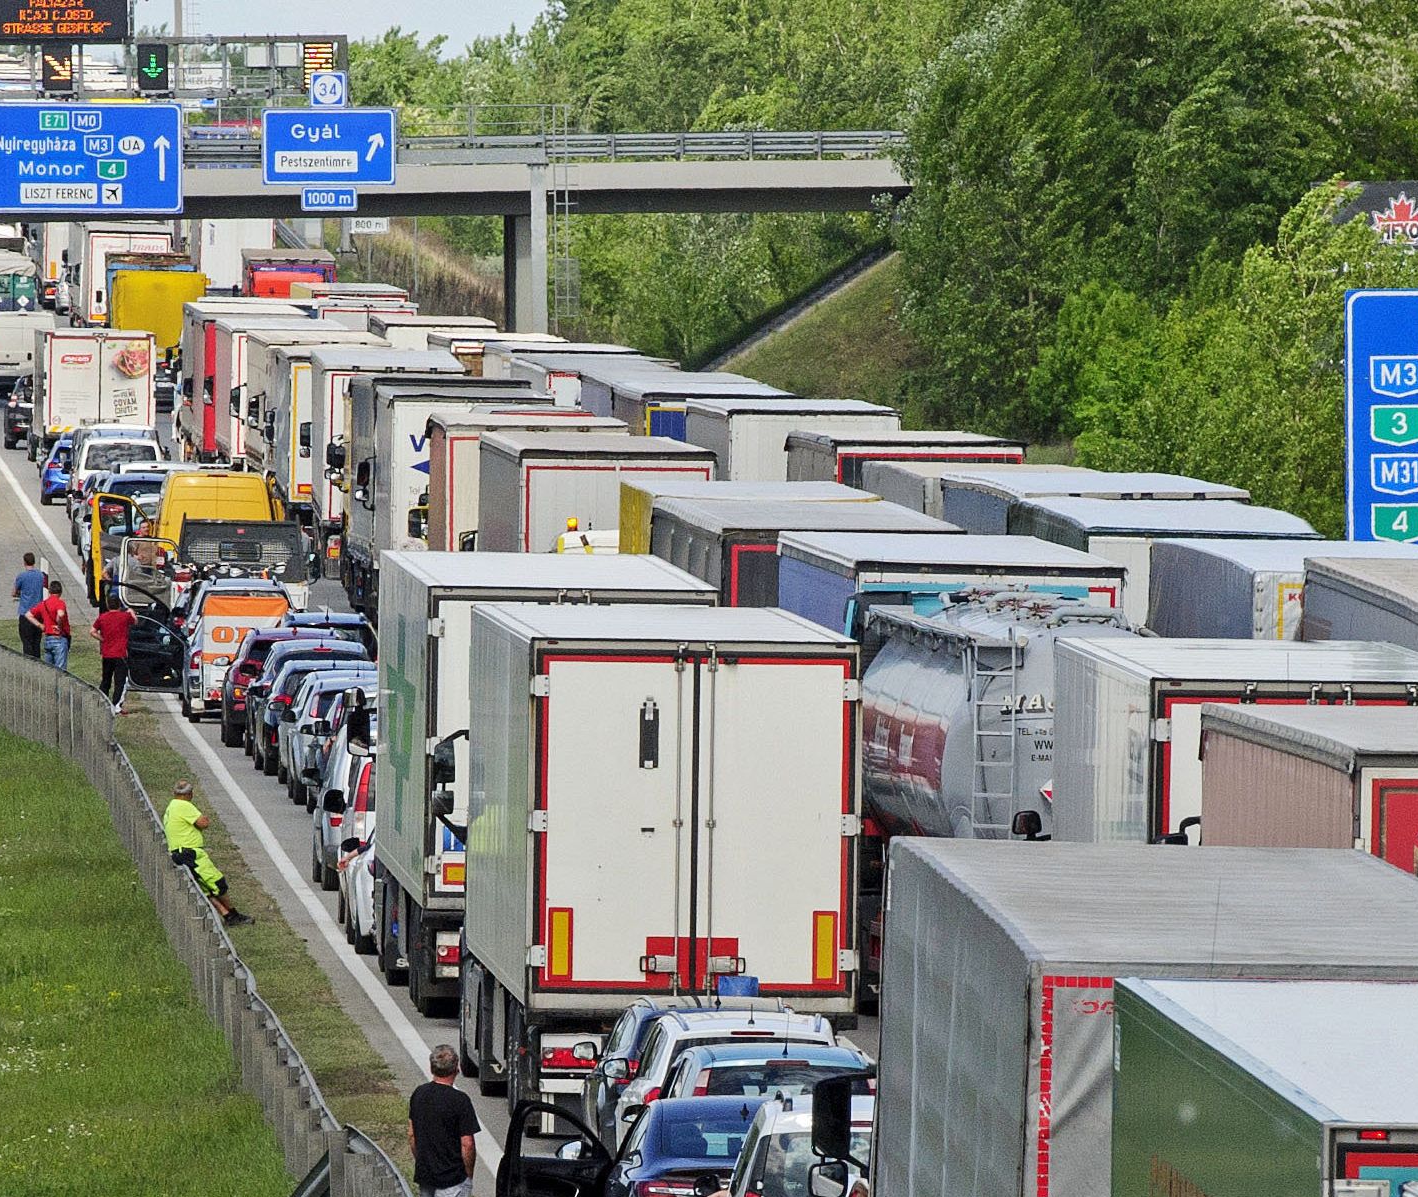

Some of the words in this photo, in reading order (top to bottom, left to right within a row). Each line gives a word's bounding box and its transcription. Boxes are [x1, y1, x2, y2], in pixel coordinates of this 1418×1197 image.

[318, 83, 337, 97] 34
[77, 115, 97, 127] M0
[290, 123, 341, 142] Gyál
[88, 139, 109, 151] M3
[122, 139, 141, 151] UA
[18, 160, 85, 176] Monor
[280, 155, 353, 168] Pestszentimre
[107, 163, 117, 175] 4
[24, 187, 52, 200] LISZT
[55, 187, 93, 200] FERENC
[307, 192, 336, 205] 1000
[338, 194, 351, 205] m
[1380, 363, 1418, 386] M3
[1391, 412, 1408, 435] 3
[1391, 510, 1409, 532] 4
